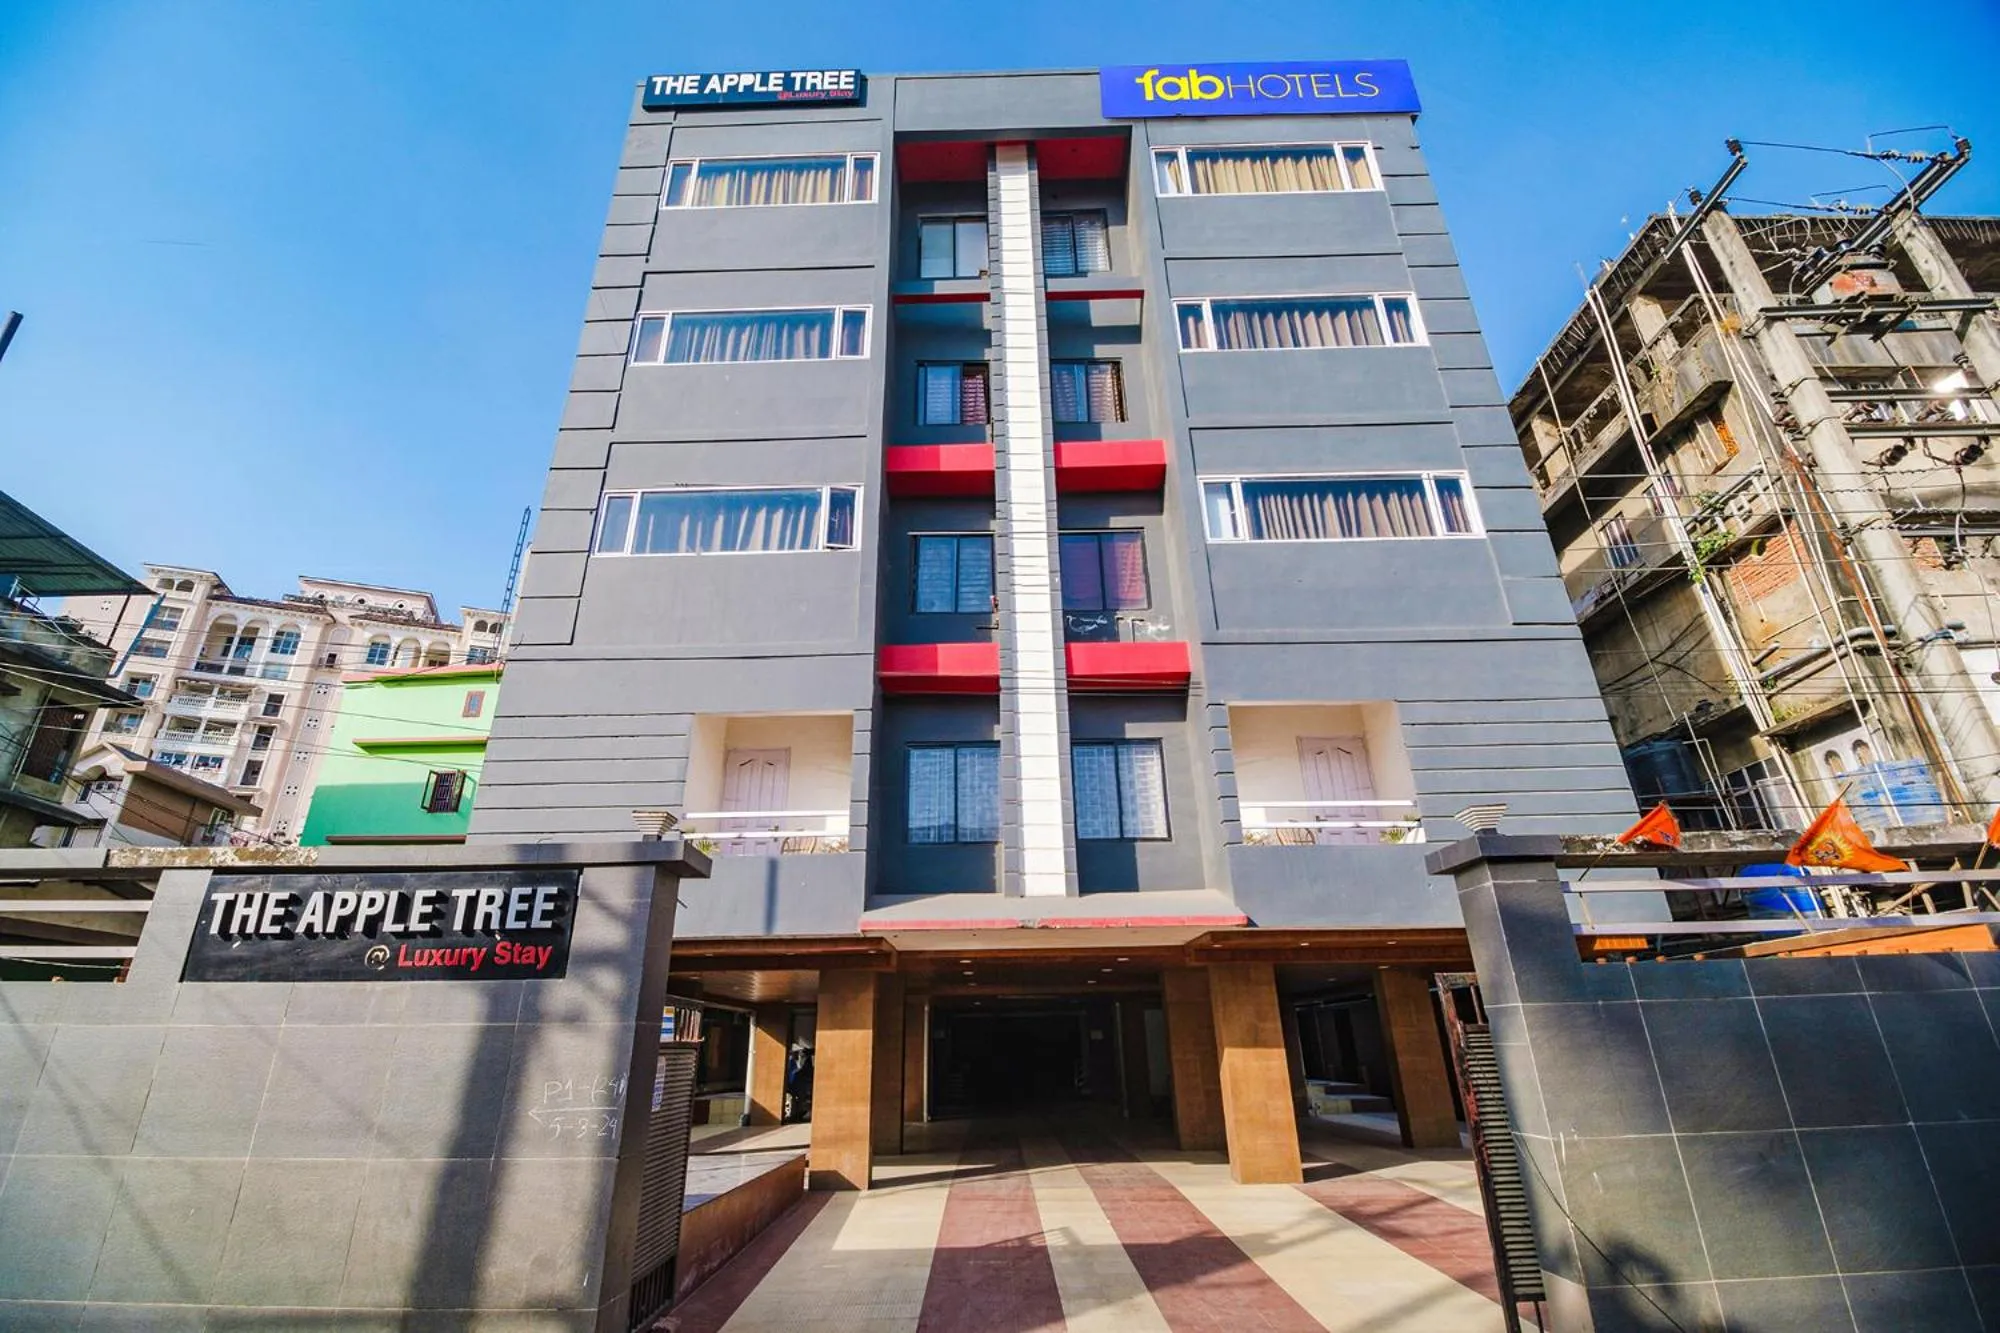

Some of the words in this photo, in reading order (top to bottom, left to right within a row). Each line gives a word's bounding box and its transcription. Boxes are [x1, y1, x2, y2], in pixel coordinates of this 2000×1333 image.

[652, 75, 702, 95] THE
[704, 73, 784, 94] APPLE
[790, 70, 856, 91] TREE
[209, 891, 292, 935] THE
[296, 888, 436, 933] APPLE
[451, 886, 560, 932] TREE
[397, 943, 488, 972] Luxury
[494, 940, 553, 970] Stay
